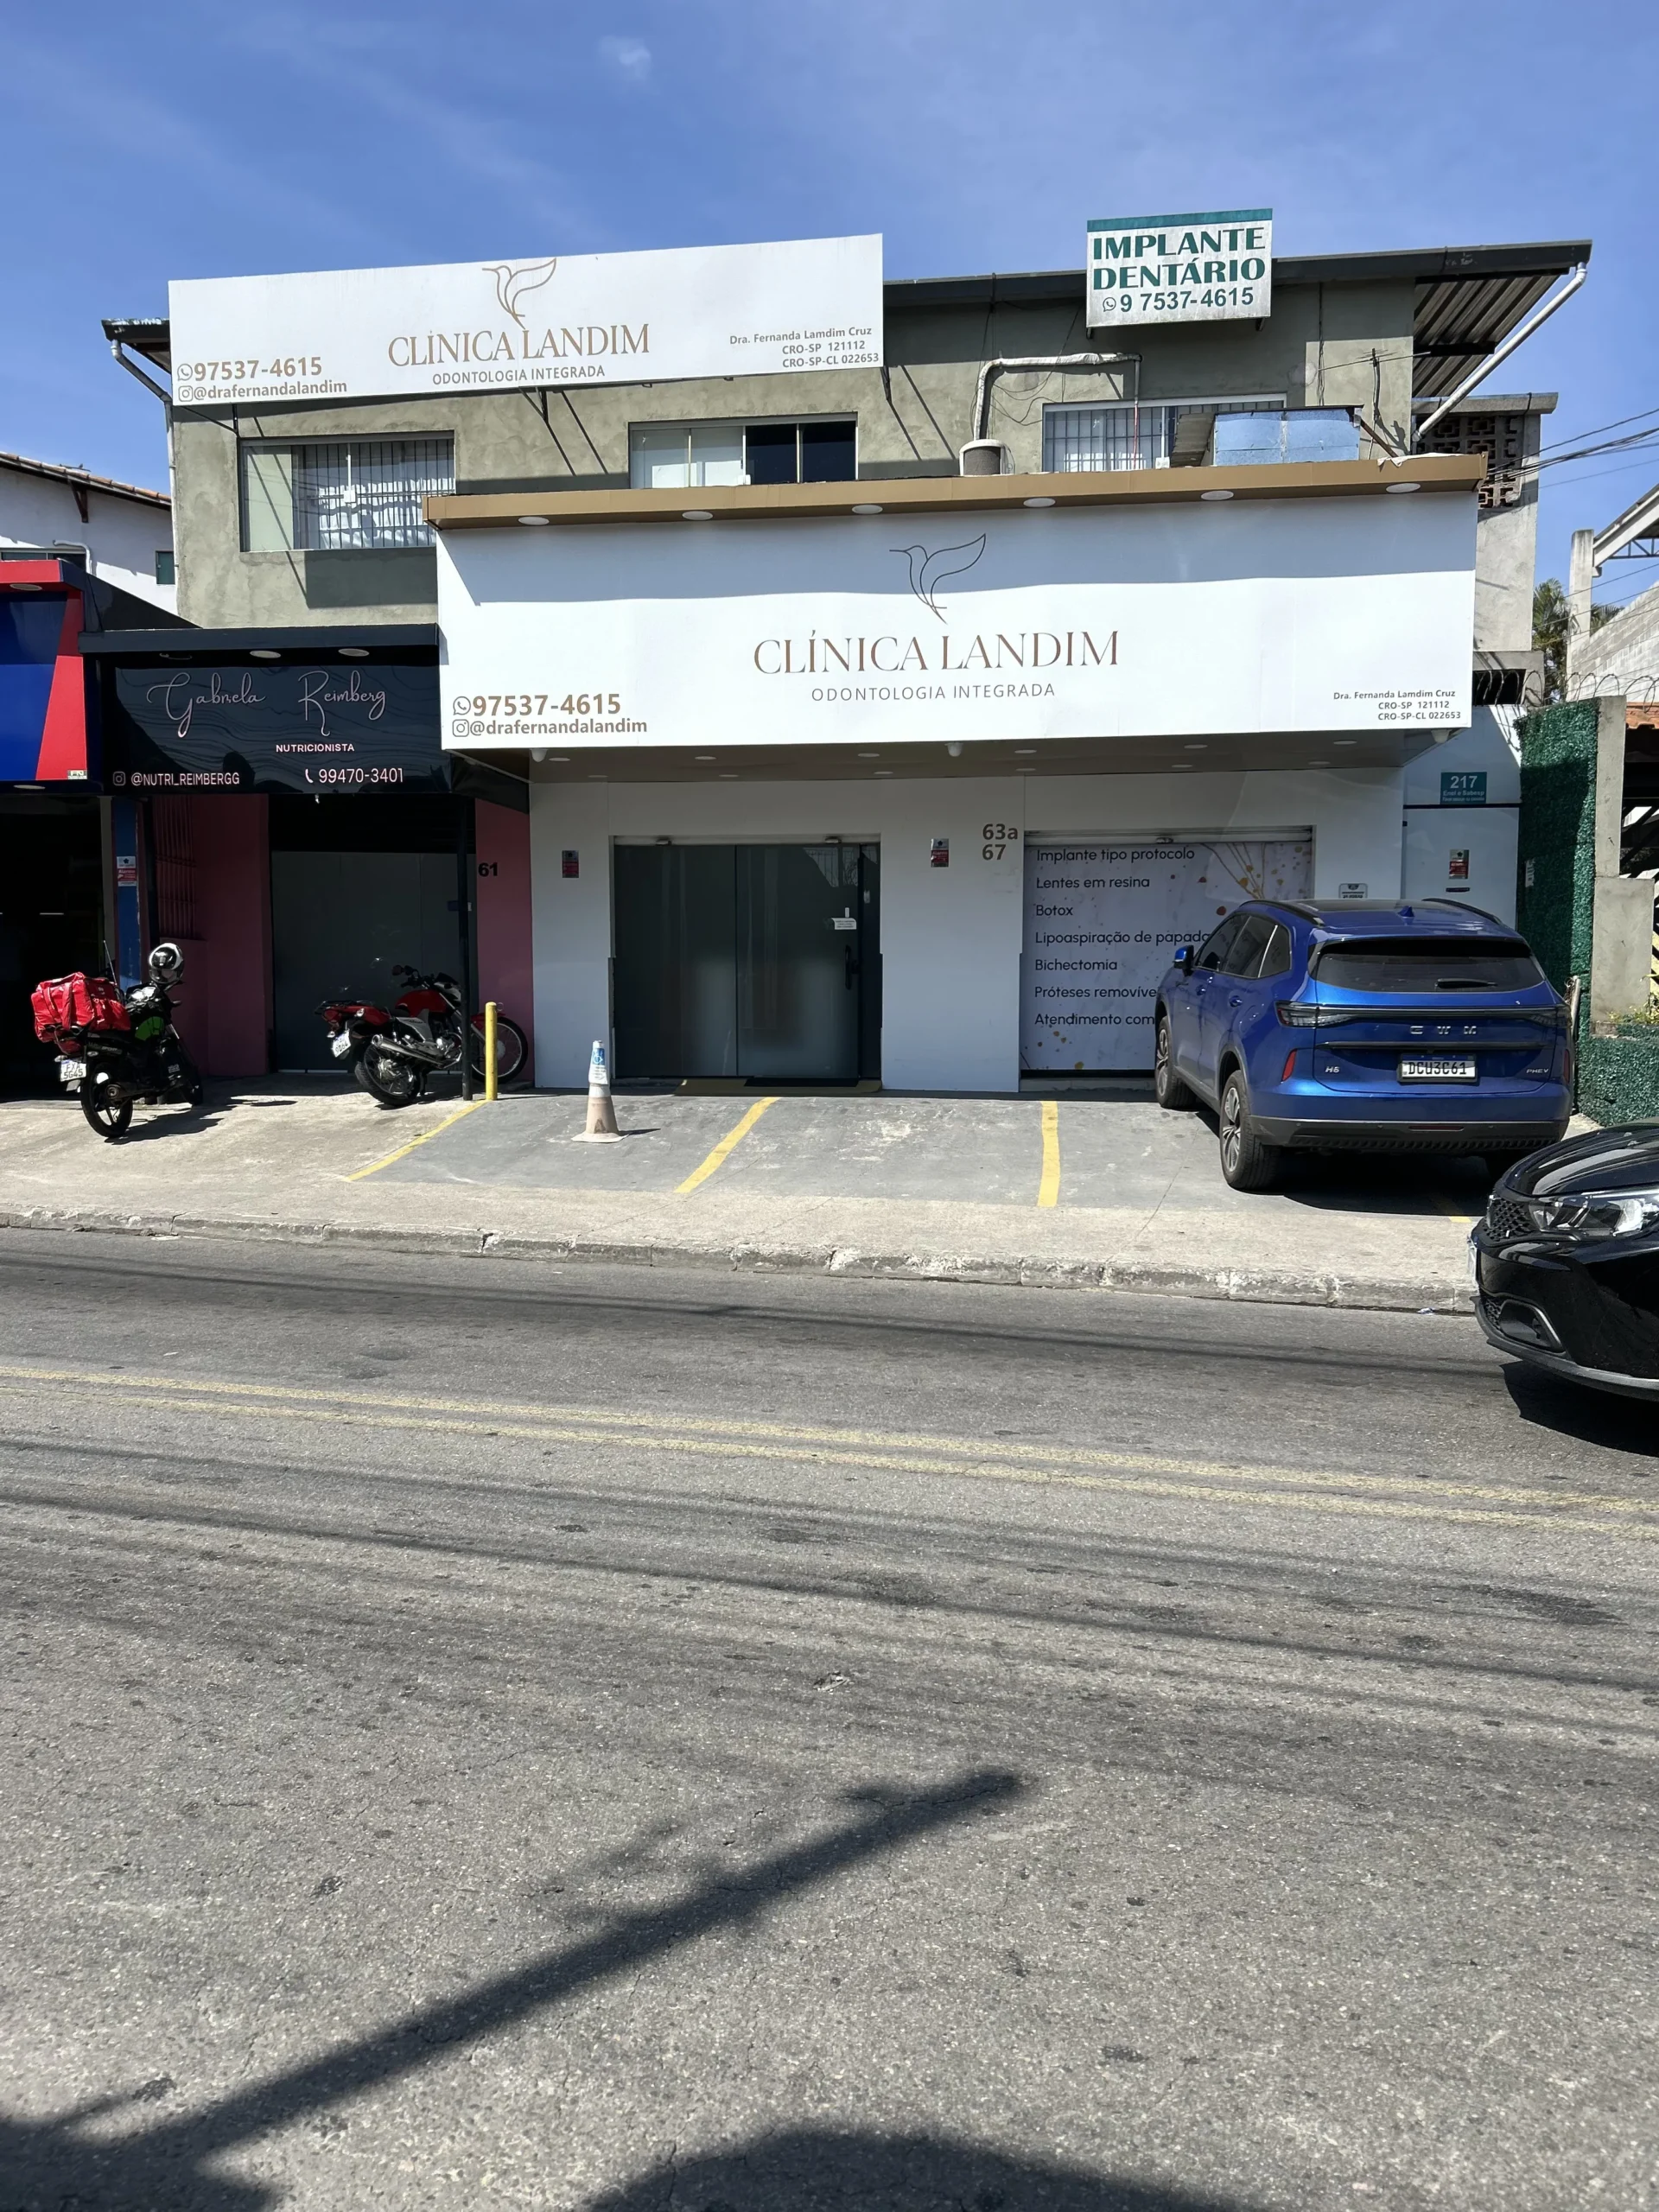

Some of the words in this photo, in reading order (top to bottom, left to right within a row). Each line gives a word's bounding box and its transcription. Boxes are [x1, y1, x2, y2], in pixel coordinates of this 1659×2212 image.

[1093, 226, 1266, 260] IMPLANTE
[1093, 257, 1266, 290] DENTÁRIO
[1120, 294, 1133, 313] 9
[1140, 286, 1254, 312] 7537-4615
[388, 329, 515, 366] CLÍNICA
[522, 323, 650, 359] LANDIM
[729, 334, 751, 346] Dra.
[753, 330, 801, 343] Fernanda
[804, 327, 846, 340] Lamdim
[849, 326, 873, 337] Cruz
[782, 342, 822, 355] CRO-SP
[828, 340, 866, 353] 121112
[782, 355, 839, 368] CRO-SP-CL
[841, 352, 880, 365] 022653
[194, 356, 323, 382] 97537-4615
[432, 368, 527, 385] ODONTOLOGIA
[531, 364, 606, 381] INTEGRADA
[194, 380, 347, 401] @drafernandalandim
[753, 629, 929, 675] CLÍNICA
[940, 630, 1119, 671] LANDIM
[811, 685, 946, 702] ODONTOLOGIA
[953, 683, 1055, 699] INTEGRADA
[1354, 690, 1395, 700] Fernanda
[1397, 690, 1433, 699] Lamdim
[146, 672, 266, 738] Gabriela
[297, 670, 387, 737] Reimberg
[472, 692, 621, 717] 97537-4615
[1378, 702, 1413, 710] CRO-SP
[1417, 701, 1450, 709] 121112
[1377, 712, 1427, 721] CRO-SP-CL
[1428, 711, 1461, 720] 022653
[469, 717, 648, 736] @drafernandalandim
[275, 742, 355, 753] NUTRICIONISTA
[130, 772, 240, 787] @NUTRI_REIMBERGG
[318, 767, 404, 784] 99470-3401
[1450, 775, 1478, 789] 217
[982, 823, 1019, 841] 63a
[982, 843, 1007, 861] 67
[1037, 849, 1097, 865] Implante
[1100, 848, 1128, 863] tipo
[1131, 847, 1195, 863] protocolo
[478, 861, 499, 878] 61
[1036, 877, 1080, 888] Lentes
[1084, 879, 1106, 888] em
[1109, 876, 1150, 888] resina
[1036, 905, 1073, 916] Botox
[1035, 931, 1131, 946] Lipoaspiração
[1134, 931, 1153, 943] de
[1035, 958, 1117, 971] Bichectomia
[1034, 986, 1090, 998] Próteses
[1094, 986, 1157, 998] removíve
[1034, 1013, 1122, 1025] Atendimento
[1408, 1061, 1467, 1075] DCU3C61
